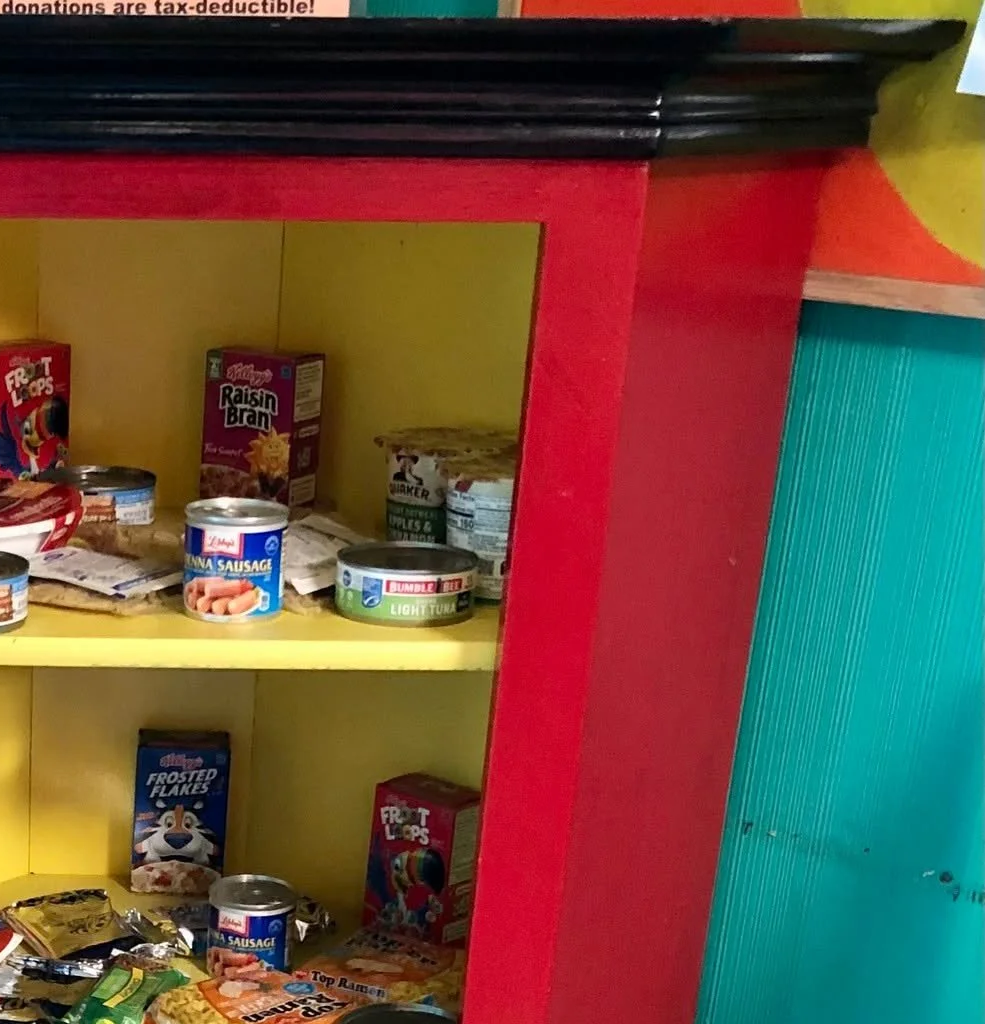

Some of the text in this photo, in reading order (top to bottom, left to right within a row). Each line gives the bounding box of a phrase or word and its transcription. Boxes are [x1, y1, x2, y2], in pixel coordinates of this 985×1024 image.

[2, 0, 106, 15] donations
[113, 2, 147, 15] are
[155, 0, 315, 14] tax-deductible!
[11, 376, 54, 408] LOOPS
[220, 385, 278, 415] Raisin
[225, 405, 271, 431] Bran
[389, 483, 430, 500] QUAKER
[217, 558, 273, 572] SAUSAGE
[389, 579, 462, 593] BUMBLE BEE
[390, 603, 457, 616] LIGHT TUNA
[146, 768, 218, 786] FROSTED
[149, 781, 211, 798] FLAKES
[311, 970, 386, 998] Top Ramen
[241, 993, 336, 1023] Ramen
